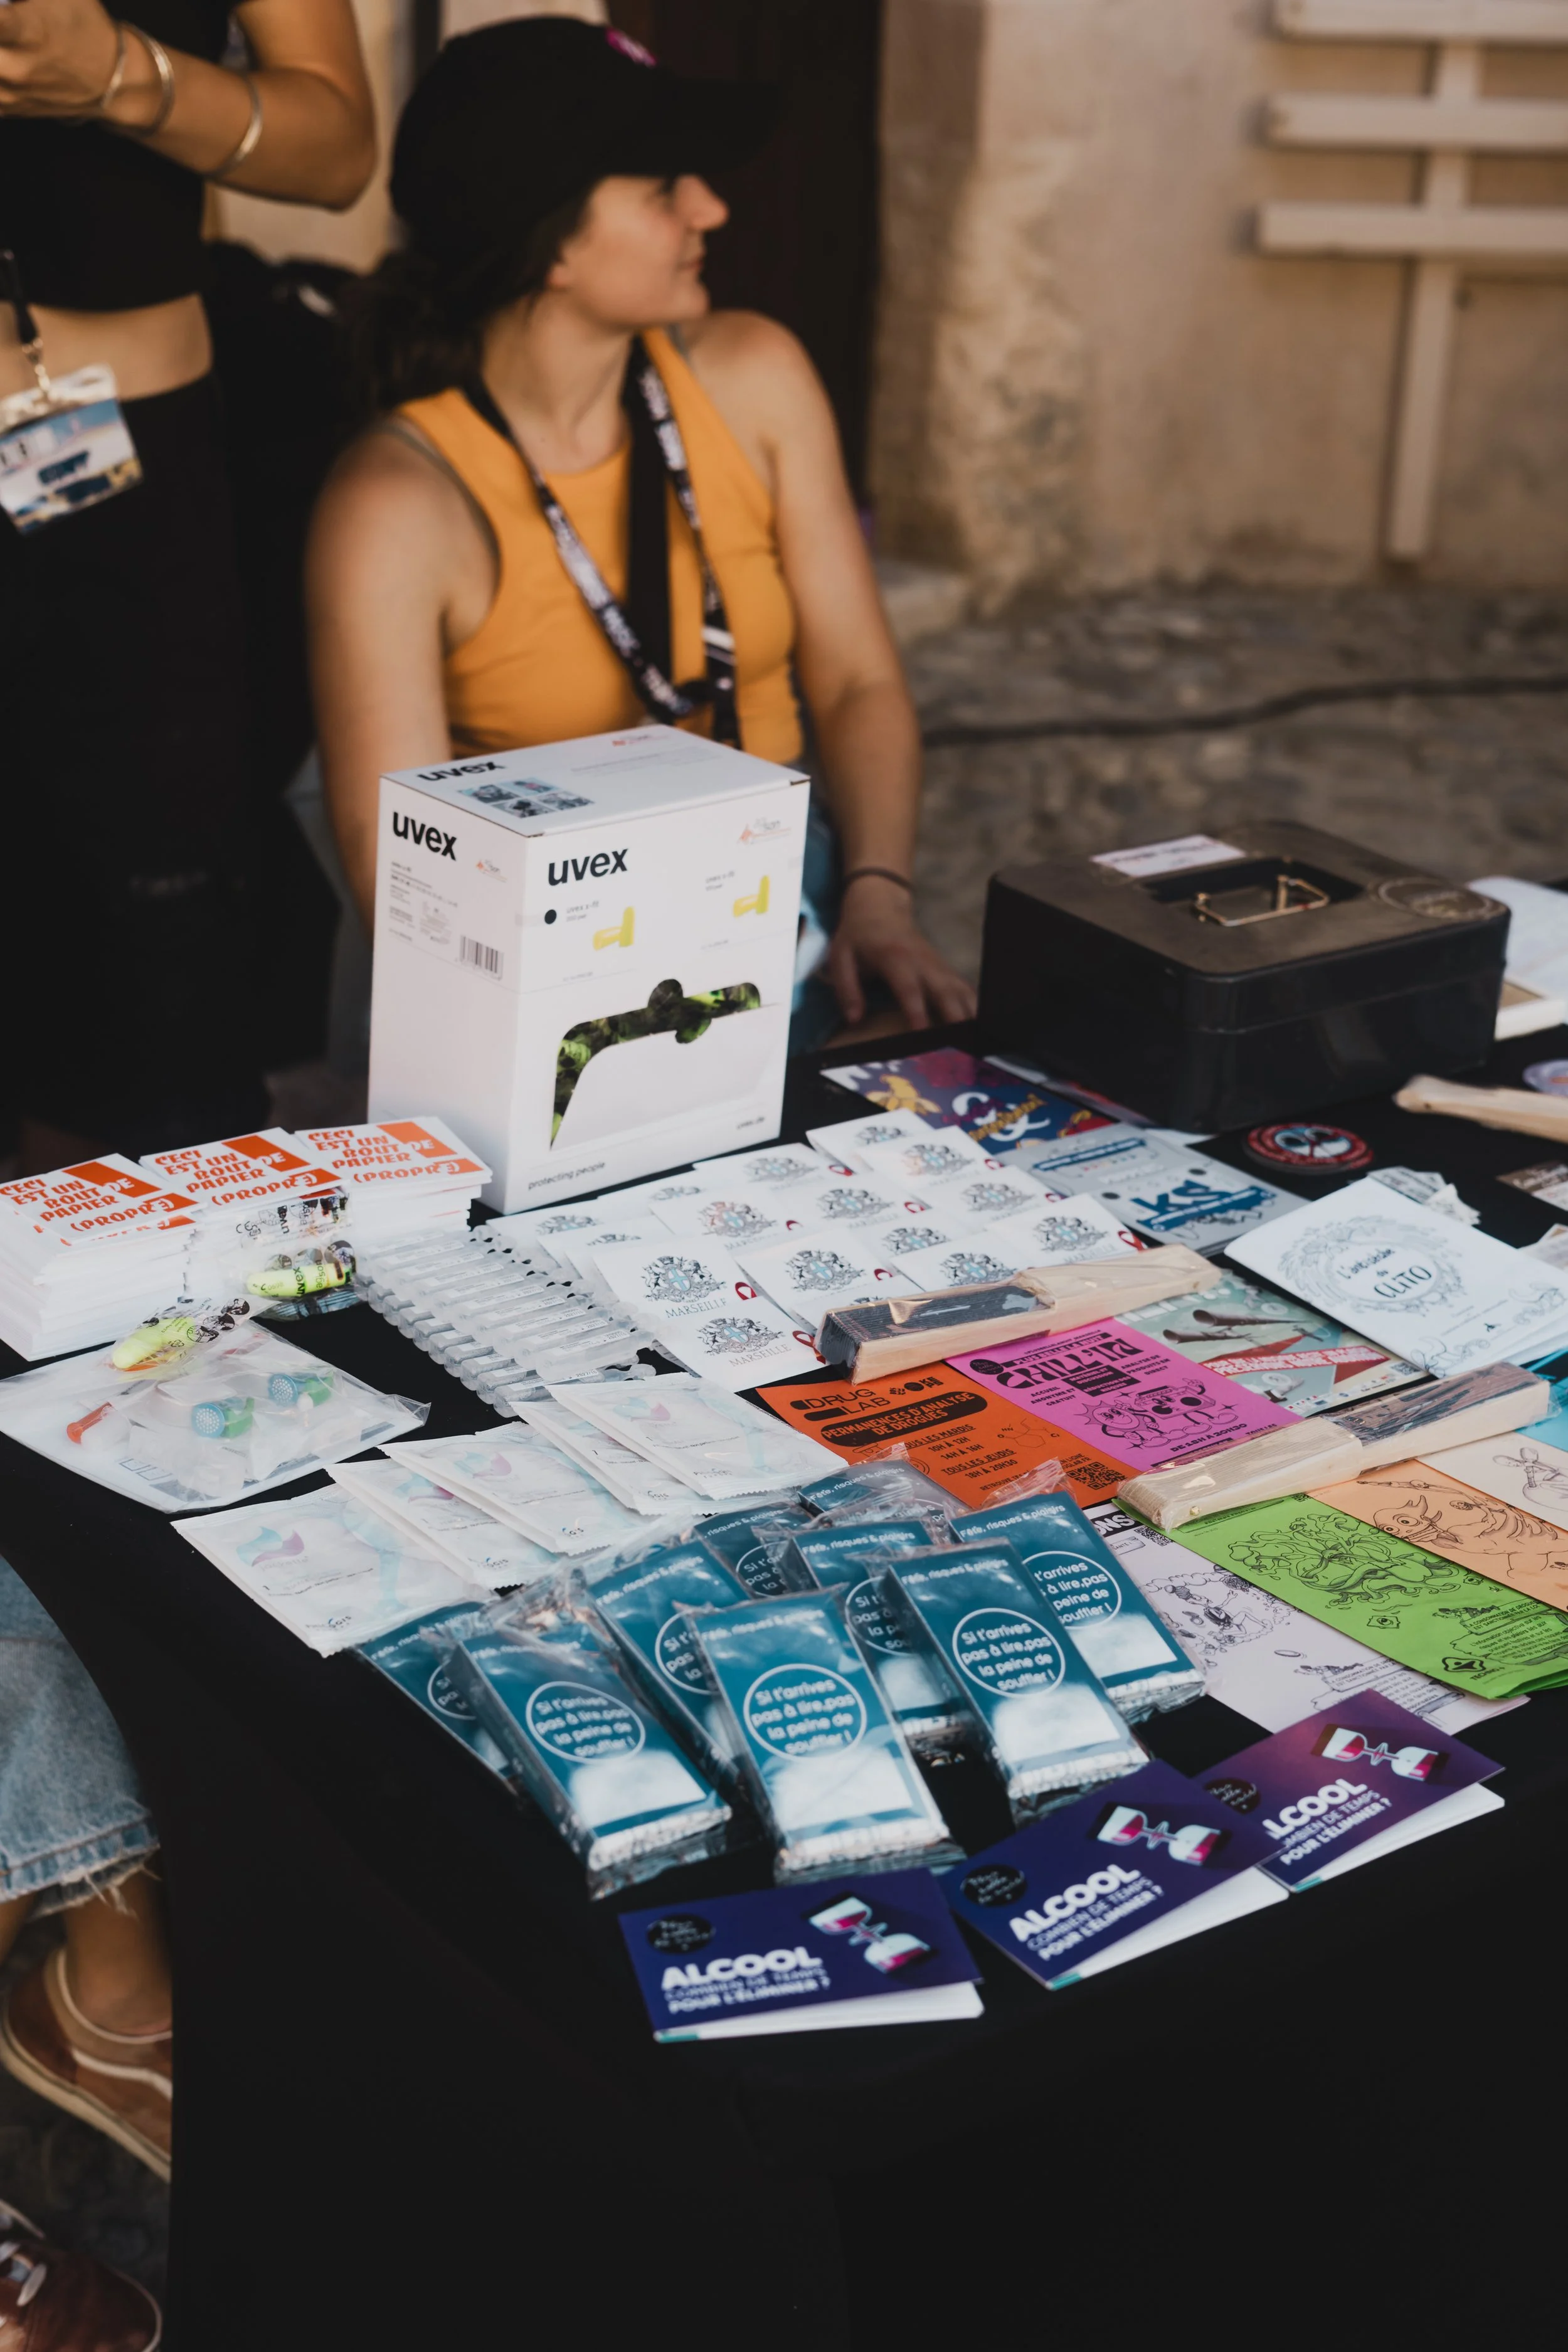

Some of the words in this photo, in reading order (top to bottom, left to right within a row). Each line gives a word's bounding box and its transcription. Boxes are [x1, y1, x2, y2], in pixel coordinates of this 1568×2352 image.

[417, 760, 507, 781] uvex
[392, 811, 457, 861] uvex
[548, 848, 629, 887] uvex
[308, 1130, 355, 1142] CECI
[315, 1139, 351, 1152] EST
[357, 1135, 389, 1147] UN
[155, 1150, 202, 1165] CECI
[342, 1143, 400, 1158] BOUT
[411, 1139, 435, 1152] DE
[164, 1160, 201, 1175] EST
[205, 1153, 238, 1167] UN
[193, 1160, 251, 1180] BOUT
[262, 1152, 286, 1166] DE
[332, 1152, 412, 1169] PAPIER
[186, 1168, 267, 1193] PAPIER
[11, 1189, 49, 1205] EST
[51, 1180, 85, 1195] UN
[43, 1187, 102, 1209] BOUT
[110, 1178, 135, 1192] DE
[40, 1194, 121, 1222] PAPIER
[292, 1266, 307, 1295] uvex
[665, 1297, 728, 1318] MARSEILLE
[729, 1343, 792, 1367] MARSEILLE
[1012, 1353, 1040, 1366] PLUS
[1120, 1357, 1151, 1370] ANALYSE
[1150, 1354, 1161, 1362] DE
[1128, 1361, 1160, 1374] PRODUITS
[1144, 1365, 1169, 1375] DIRECT
[1030, 1386, 1061, 1397] ACCUEIL
[1030, 1391, 1067, 1405] ANONYME
[1066, 1387, 1077, 1396] ET
[1099, 1382, 1128, 1392] RISQUES
[805, 1388, 877, 1411] DRUG
[840, 1397, 891, 1416] LAB
[1046, 1394, 1077, 1406] GRATUIT
[820, 1407, 912, 1439] PERMANENCES
[907, 1391, 976, 1421] D'ANALYSE
[871, 1425, 894, 1436] DE
[891, 1409, 949, 1433] DROGUES
[922, 1433, 940, 1444] LES
[940, 1424, 974, 1439] MARDIS
[928, 1441, 945, 1453] 10H
[946, 1439, 954, 1448] À
[955, 1436, 972, 1446] 12H
[940, 1449, 959, 1461] 14H
[959, 1447, 968, 1457] À
[968, 1443, 984, 1454] 16H
[1170, 1444, 1185, 1453] DE
[941, 1463, 964, 1475] TOUS
[965, 1457, 983, 1470] LES
[983, 1448, 1015, 1465] JEUDIS
[964, 1468, 983, 1480] 18H
[989, 1459, 1019, 1473] 20H30
[810, 1488, 835, 1501] Fête,
[834, 1475, 867, 1491] risques
[873, 1467, 905, 1478] plaisirs
[979, 1476, 1011, 1491] RETROUVE
[706, 1520, 742, 1537] risques
[750, 1510, 784, 1522] plaisirs
[960, 1525, 987, 1539] Fête,
[985, 1515, 1023, 1531] risques
[1022, 1513, 1031, 1522] &
[1030, 1505, 1066, 1519] plaisirs
[802, 1542, 830, 1555] Fête,
[830, 1537, 869, 1549] risques
[878, 1531, 916, 1544] plaisirs
[743, 1562, 759, 1573] Si
[928, 1565, 965, 1580] risques
[973, 1559, 1009, 1571] plaisirs
[1034, 1562, 1089, 1582] t'arrives
[744, 1572, 772, 1587] pas
[761, 1581, 778, 1591] la
[1047, 1583, 1059, 1595] à
[854, 1595, 871, 1609] Si
[1052, 1592, 1091, 1611] peine
[1091, 1587, 1110, 1600] de
[852, 1611, 881, 1625] pas
[1058, 1603, 1104, 1623] souffler
[867, 1626, 884, 1638] la
[961, 1630, 979, 1646] Si
[976, 1623, 1032, 1641] t'arrives
[663, 1636, 681, 1653] Si
[960, 1648, 991, 1666] pas
[988, 1643, 1003, 1657] à
[665, 1652, 695, 1674] pas
[977, 1664, 997, 1677] la
[995, 1657, 1035, 1677] peine
[1034, 1652, 1054, 1666] de
[684, 1668, 703, 1682] la
[997, 1671, 1049, 1692] souffler
[754, 1689, 774, 1707] Si
[772, 1679, 837, 1702] t'arrives
[534, 1716, 566, 1735] pas
[751, 1708, 783, 1729] pas
[783, 1702, 798, 1719] à
[766, 1725, 788, 1740] la
[786, 1717, 831, 1739] peine
[831, 1712, 854, 1727] de
[553, 1732, 574, 1746] la
[571, 1724, 613, 1743] peine
[612, 1721, 633, 1734] de
[574, 1738, 627, 1757] souffler
[785, 1733, 844, 1756] souffler
[1262, 1777, 1368, 1841] LCOOL
[1322, 1809, 1345, 1825] DE
[1338, 1789, 1380, 1814] TEMPS
[1279, 1838, 1322, 1865] POUR
[1009, 1863, 1142, 1943] ALCOOL
[1027, 1910, 1093, 1951] COMBIEN
[1087, 1899, 1111, 1917] DE
[1106, 1876, 1154, 1905] TEMPS
[1037, 1931, 1084, 1962] POUR
[661, 1945, 824, 1991] ALCOOL
